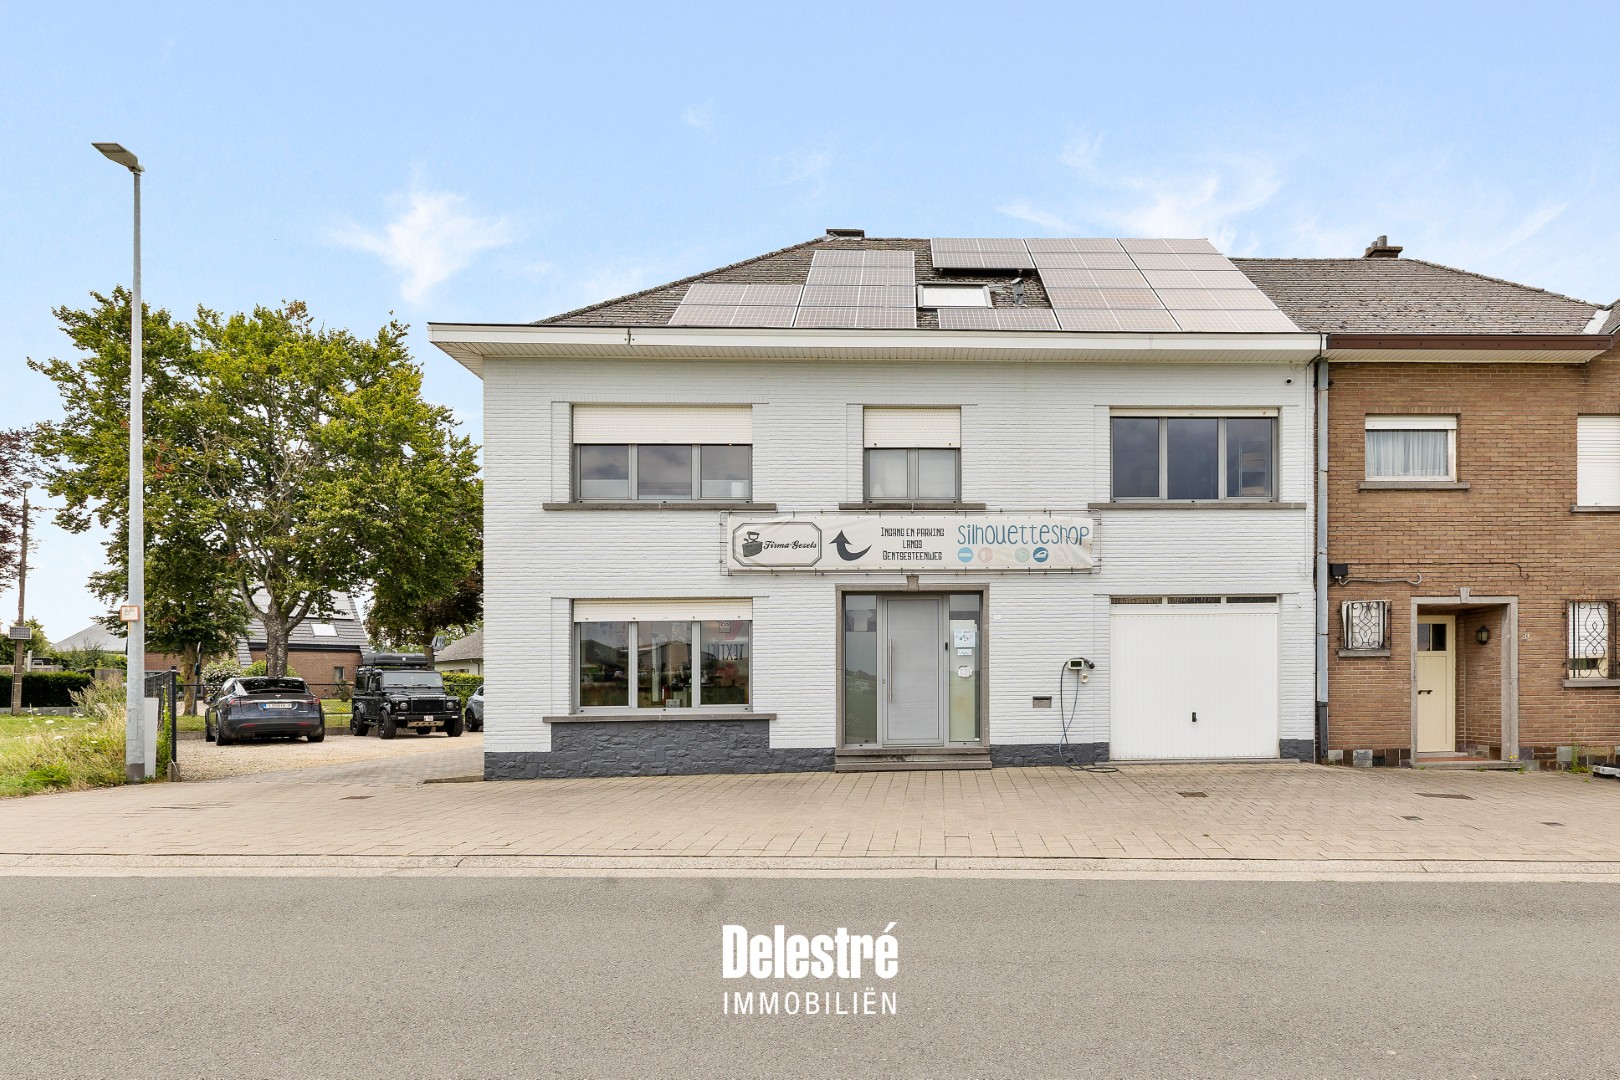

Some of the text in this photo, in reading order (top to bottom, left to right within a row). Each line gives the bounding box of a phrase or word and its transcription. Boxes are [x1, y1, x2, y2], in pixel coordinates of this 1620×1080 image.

[880, 527, 945, 537] INGANG EN PARKING
[763, 540, 790, 550] Firma
[902, 539, 923, 549] LANGS
[882, 550, 943, 561] GENTSESTEENWEG
